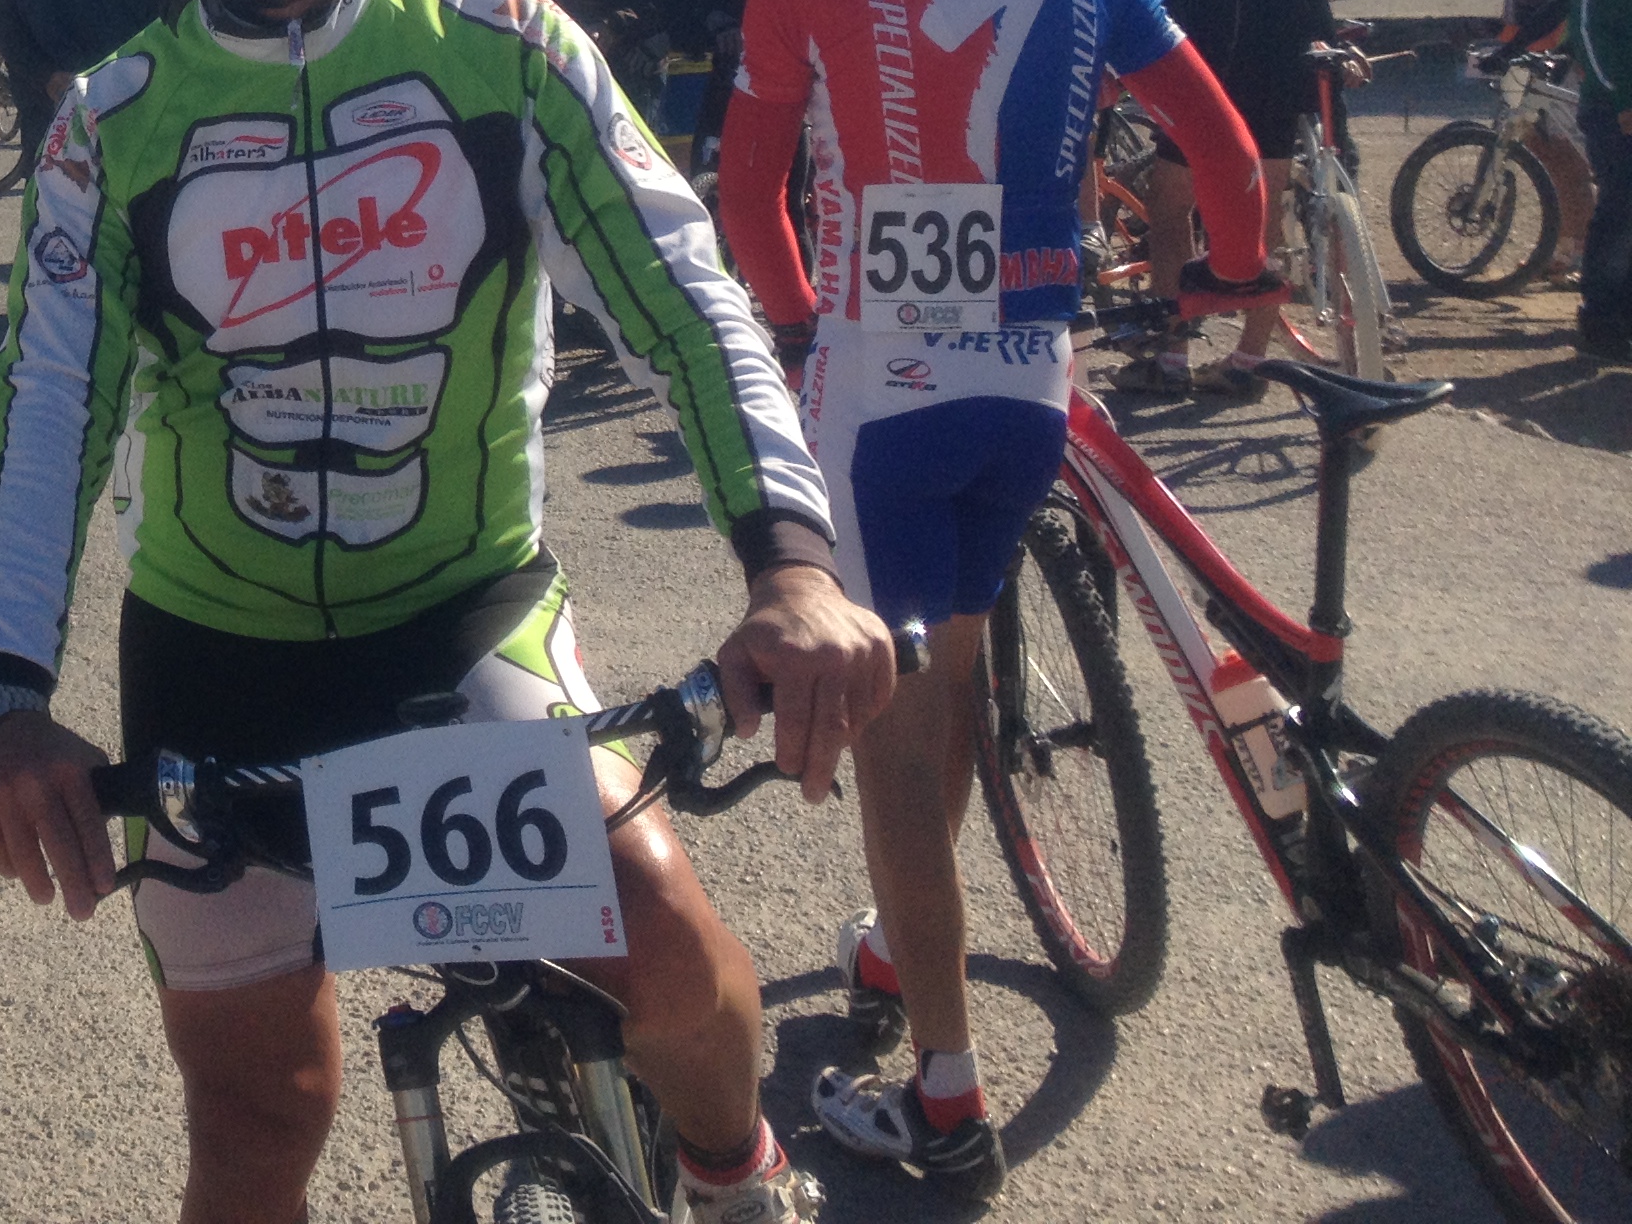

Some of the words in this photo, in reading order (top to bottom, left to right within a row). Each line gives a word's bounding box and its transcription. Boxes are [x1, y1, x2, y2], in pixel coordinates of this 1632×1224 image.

[816, 178, 844, 316] YAMAHA
[866, 209, 997, 295] 536
[1000, 246, 1079, 292] MAHA
[331, 413, 392, 427] DEPORTIVA
[351, 769, 568, 896] 566
[455, 901, 524, 937] FCCV
